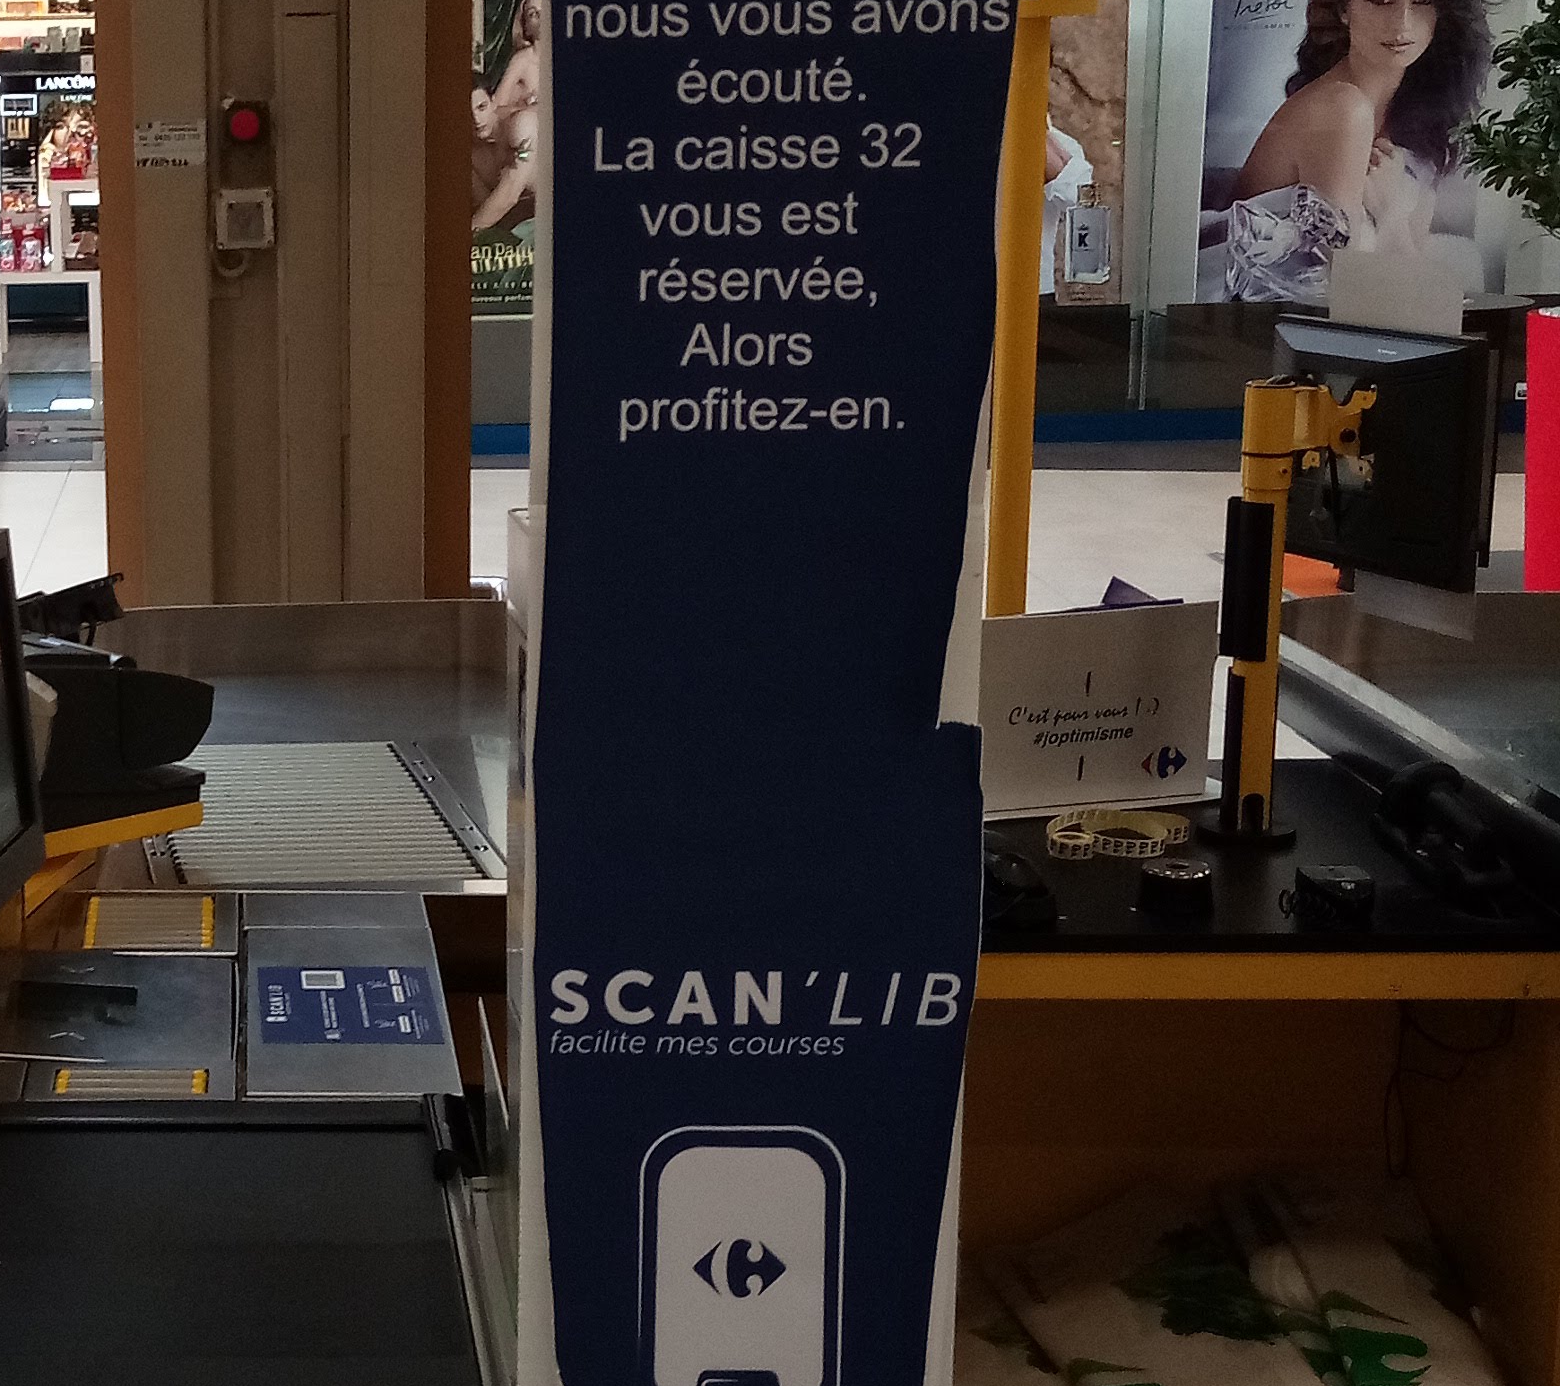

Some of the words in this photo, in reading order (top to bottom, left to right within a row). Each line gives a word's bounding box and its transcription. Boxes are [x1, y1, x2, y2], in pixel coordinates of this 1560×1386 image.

[565, 1, 690, 39] nous
[676, 56, 868, 105] écouté.
[593, 126, 656, 173] La
[673, 124, 841, 171] caisse
[858, 121, 923, 170] 32
[639, 200, 763, 237] vous
[780, 190, 859, 237] est
[638, 256, 879, 307] réservée,
[680, 321, 814, 368] Alors
[617, 387, 906, 443] profitez-en.
[1032, 725, 1134, 749] #joptimisme
[548, 968, 963, 1027] SCAN'LIB
[548, 1028, 647, 1056] facilite
[655, 1035, 719, 1056] mes
[728, 1035, 846, 1056] courses
